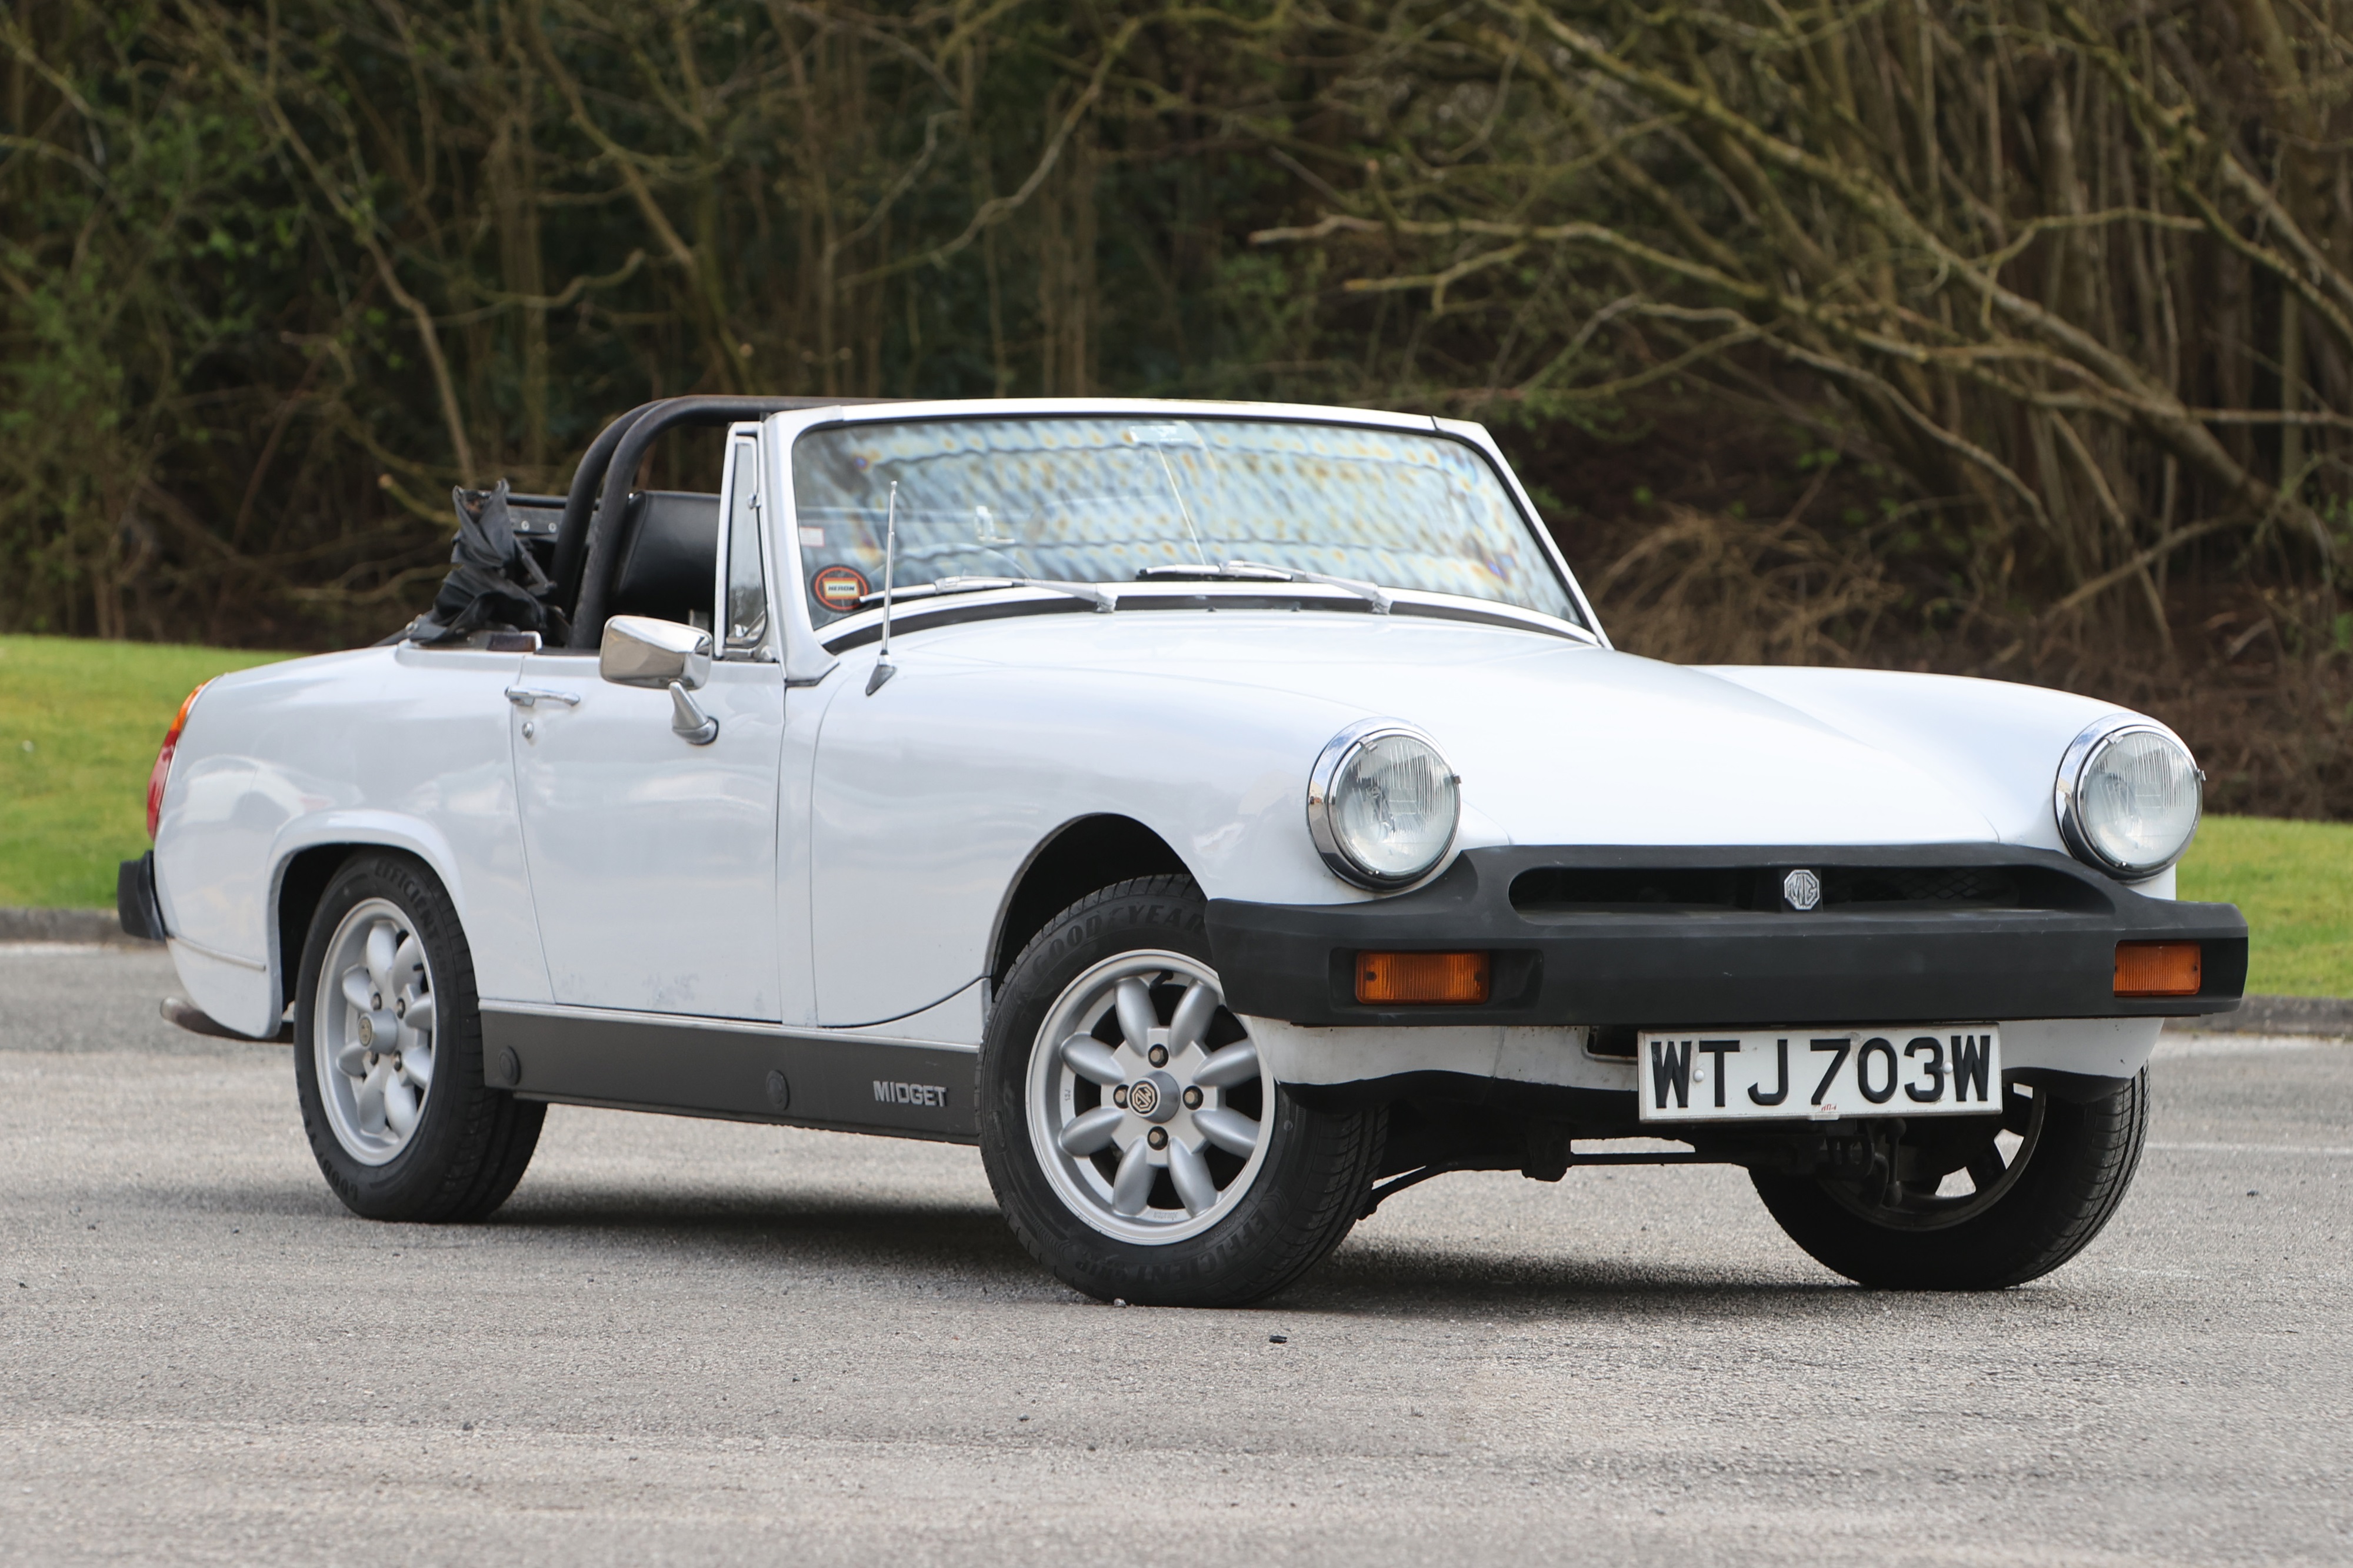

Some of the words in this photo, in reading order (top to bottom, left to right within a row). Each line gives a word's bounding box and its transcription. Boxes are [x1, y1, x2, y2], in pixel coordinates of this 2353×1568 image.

[1787, 873, 1818, 906] MG
[873, 1080, 946, 1107] MIDGET
[1134, 1085, 1154, 1110] MG
